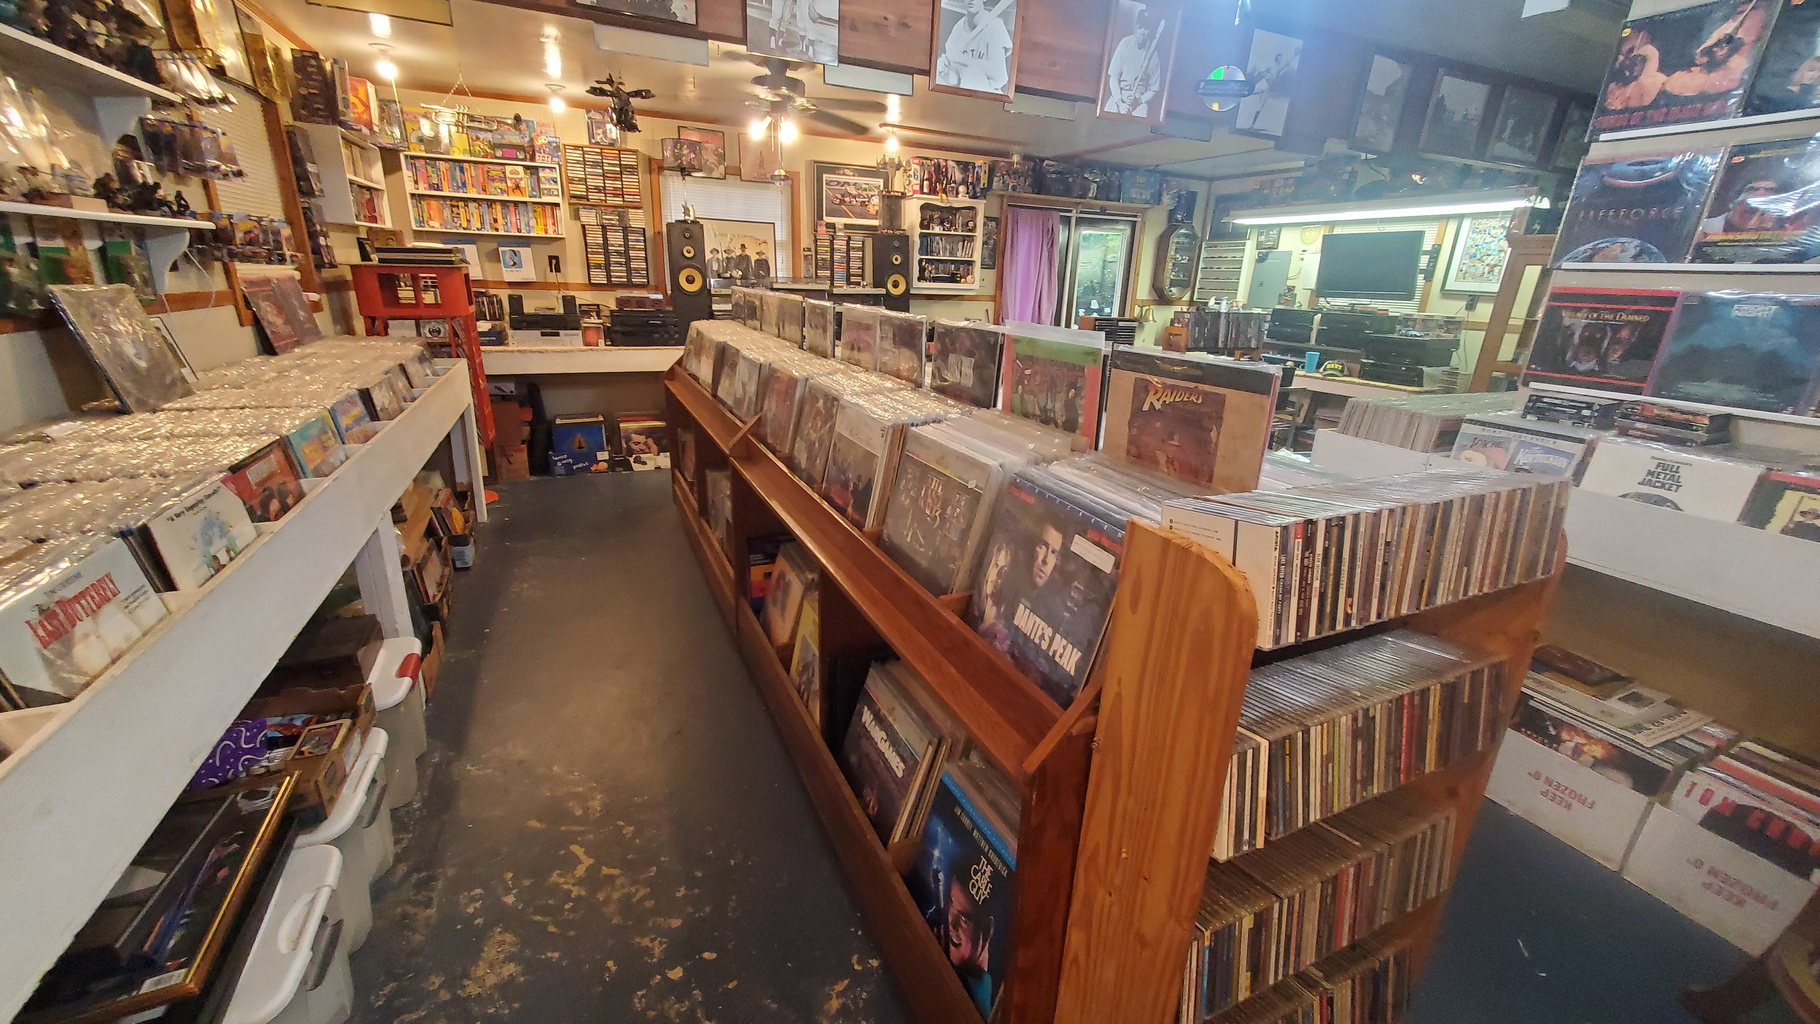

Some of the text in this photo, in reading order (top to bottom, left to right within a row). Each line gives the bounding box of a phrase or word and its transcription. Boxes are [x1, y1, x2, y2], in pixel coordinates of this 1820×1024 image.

[1142, 383, 1204, 411] RAIDERS
[1646, 469, 1682, 484] METAL
[1655, 461, 1681, 474] FULL
[1638, 477, 1683, 493] JACKET
[25, 605, 69, 650] LAST
[54, 571, 122, 630] BUTTERFLY
[1013, 602, 1082, 677] DANTE'S PEAK
[1540, 788, 1573, 811] KEEP
[1543, 775, 1596, 810] FROZEN
[970, 864, 993, 899] CABLE
[978, 854, 994, 882] THE
[968, 879, 989, 905] GUY
